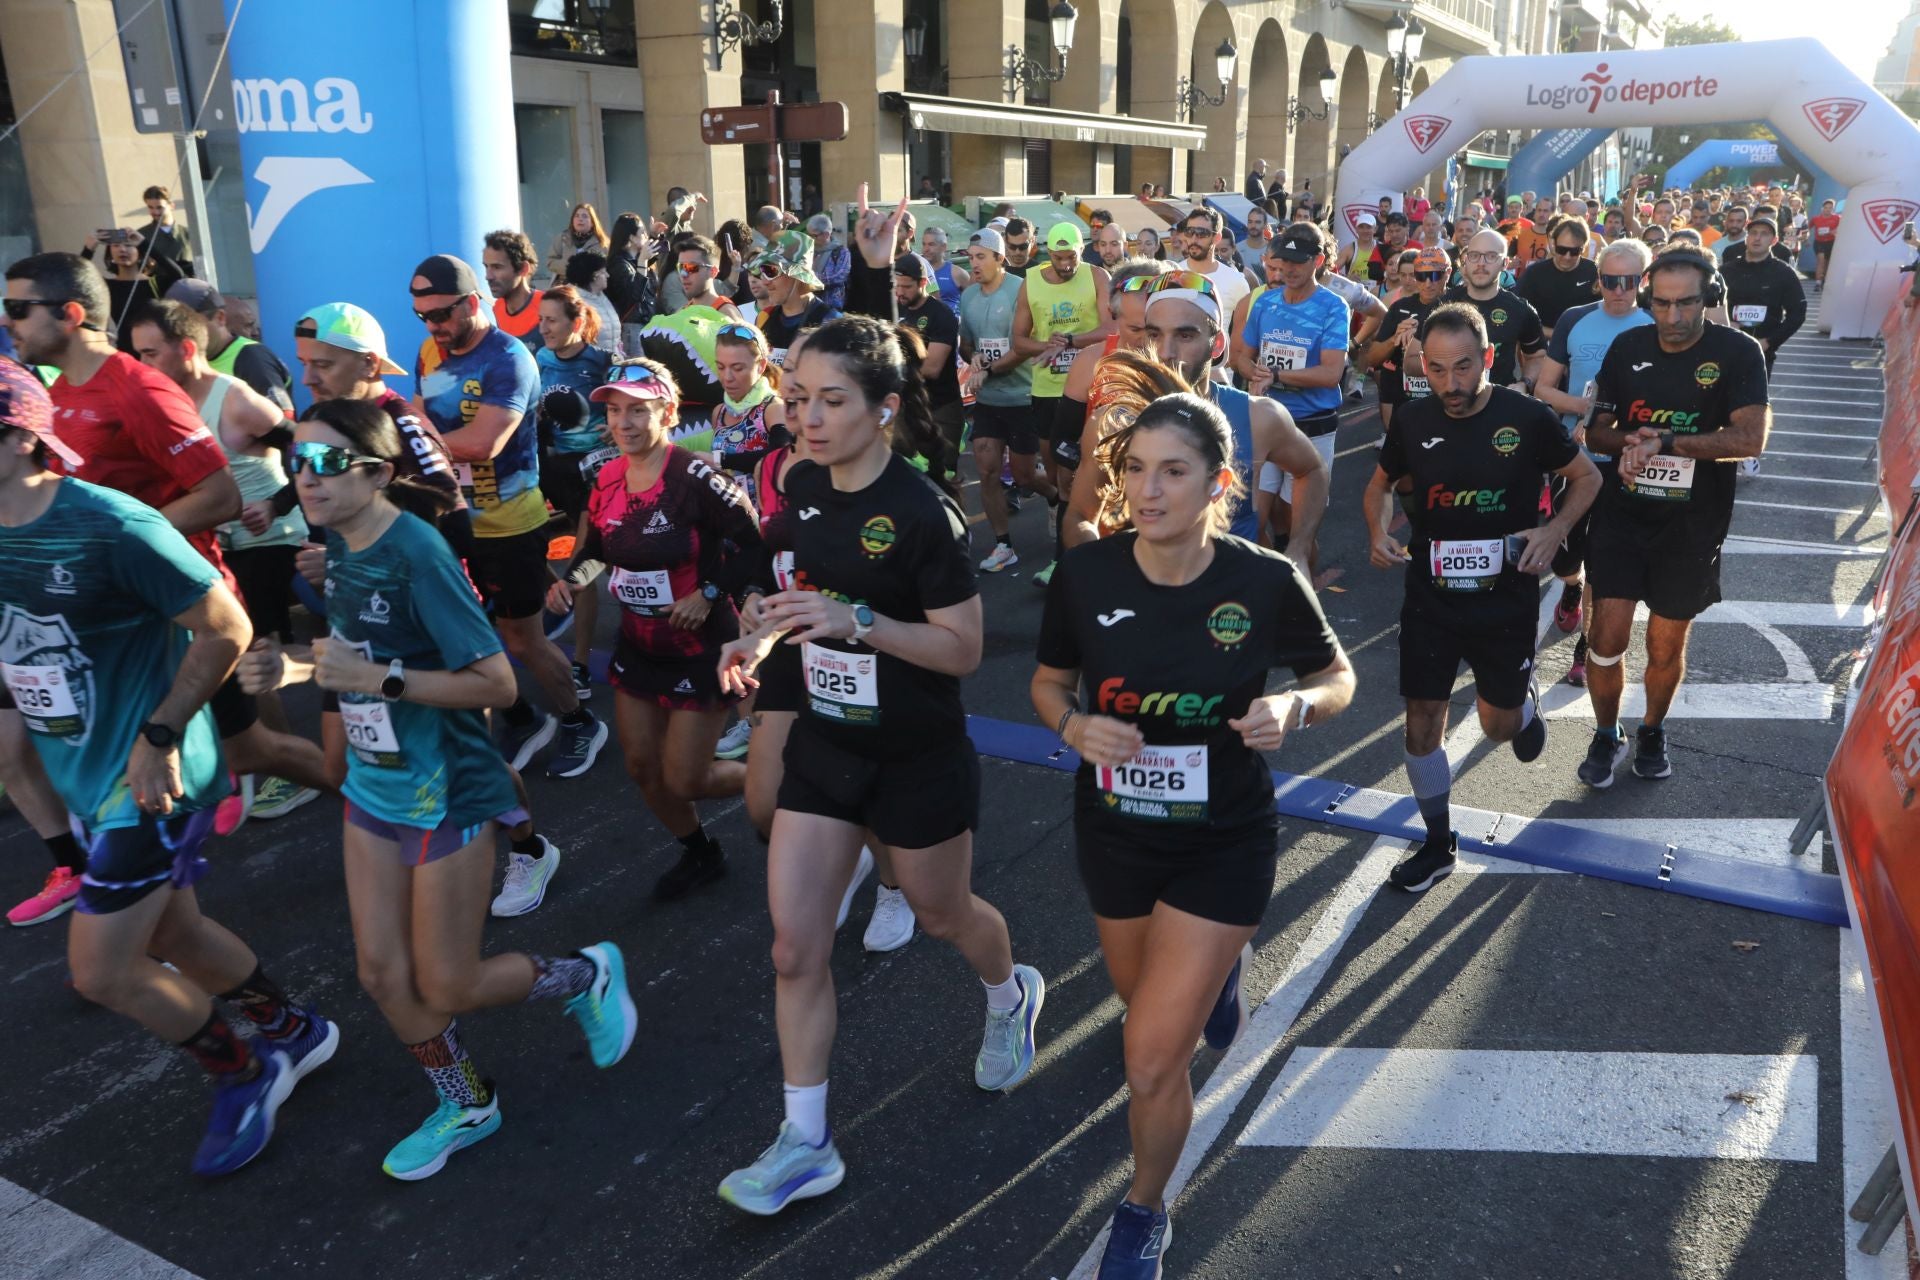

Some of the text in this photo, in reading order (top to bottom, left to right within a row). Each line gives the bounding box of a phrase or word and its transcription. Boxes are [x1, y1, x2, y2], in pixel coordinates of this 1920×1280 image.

[1620, 75, 1718, 105] deporte
[1731, 143, 1778, 155] POWER
[980, 348, 1002, 362] 39
[1267, 355, 1293, 370] 251
[1628, 400, 1700, 426] Ferrer
[397, 414, 448, 475] trail
[687, 459, 743, 508] trail
[1637, 467, 1680, 482] 2072
[1427, 483, 1506, 510] Ferrer
[1448, 547, 1455, 555] LA
[1456, 545, 1483, 555] MARATÓN
[1442, 556, 1490, 570] 2053
[618, 585, 658, 599] 1909
[809, 666, 857, 695] 1025
[1098, 677, 1224, 717] Ferrer
[1135, 755, 1175, 768] MARATÓN
[1115, 766, 1185, 790] 1026
